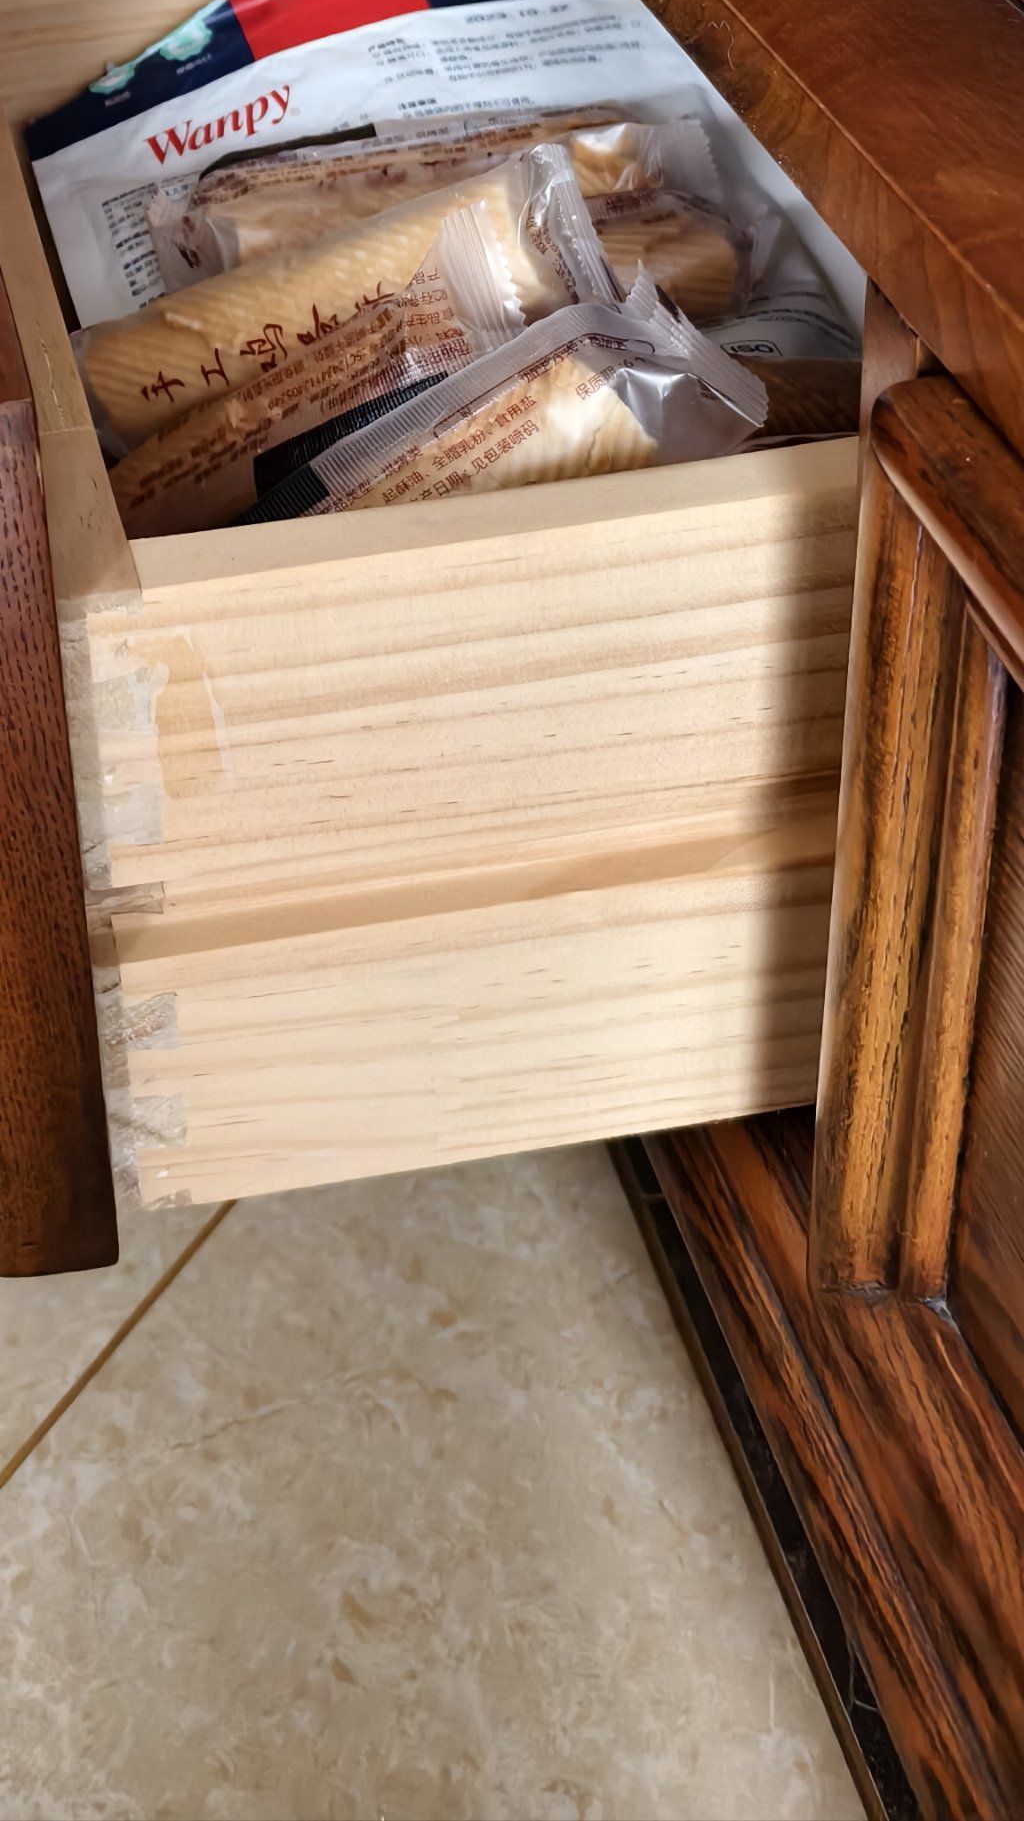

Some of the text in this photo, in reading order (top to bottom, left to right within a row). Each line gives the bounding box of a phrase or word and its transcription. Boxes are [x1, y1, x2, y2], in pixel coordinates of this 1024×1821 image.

[143, 85, 291, 165] Wanpy
[730, 343, 774, 353] ISO
[411, 419, 540, 502] 产日期：见包装喷码
